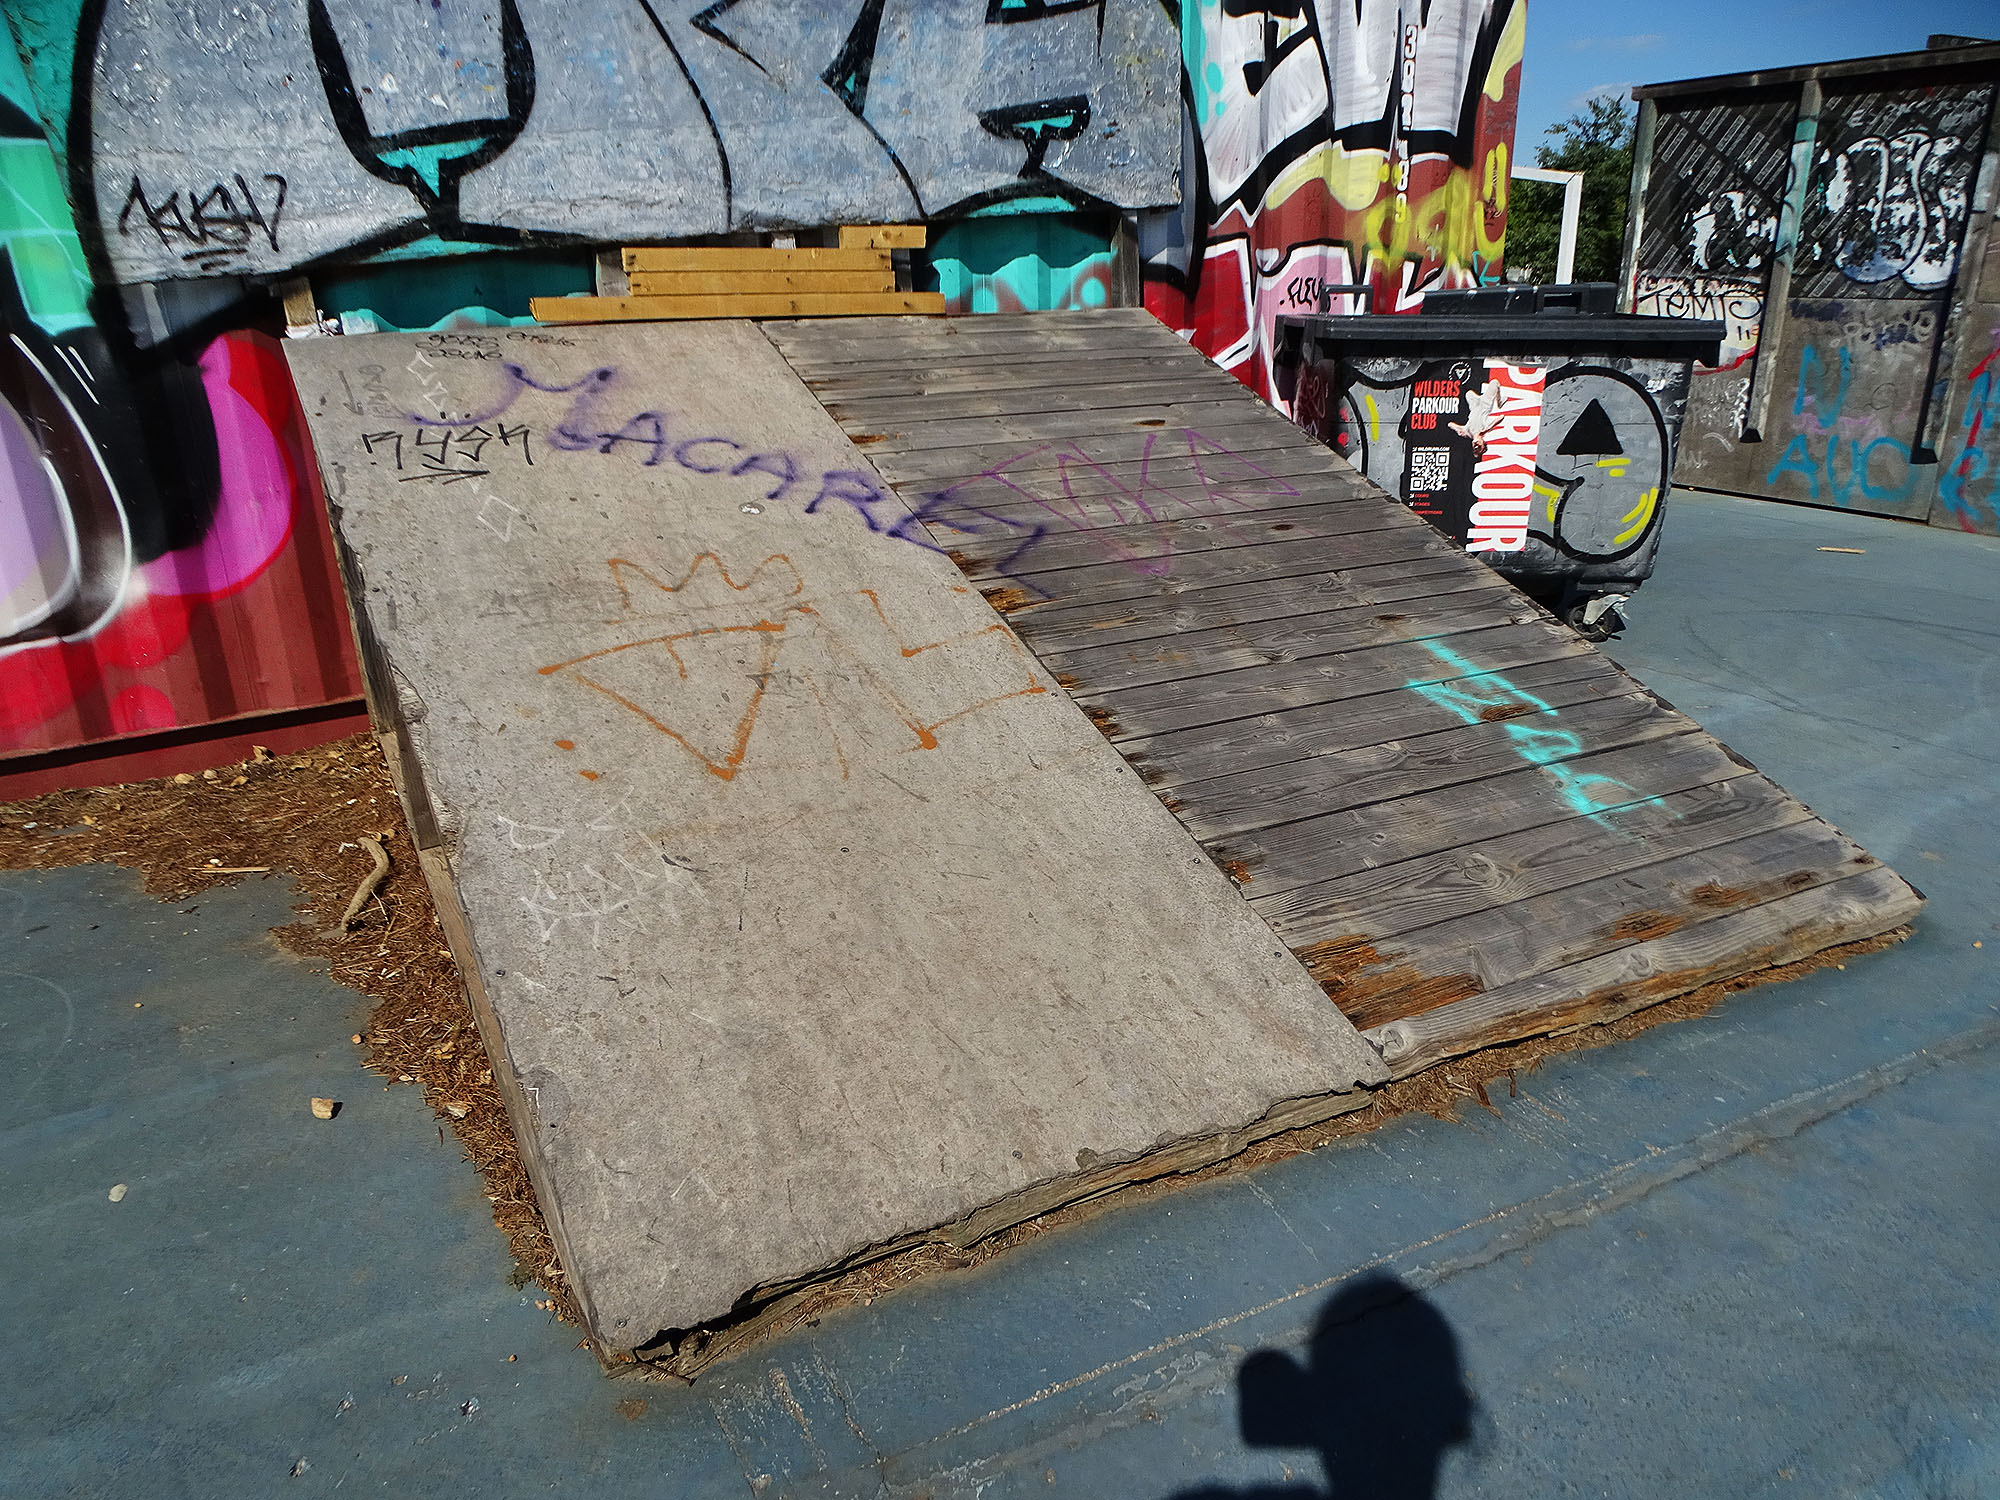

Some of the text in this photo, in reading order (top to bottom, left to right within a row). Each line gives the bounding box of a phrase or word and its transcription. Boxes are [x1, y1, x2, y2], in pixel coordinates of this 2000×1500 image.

[1414, 380, 1461, 397] WILDERS
[1411, 397, 1460, 414] PARKOUR
[1410, 413, 1437, 430] CLUB
[1465, 358, 1546, 552] PARKOUR
